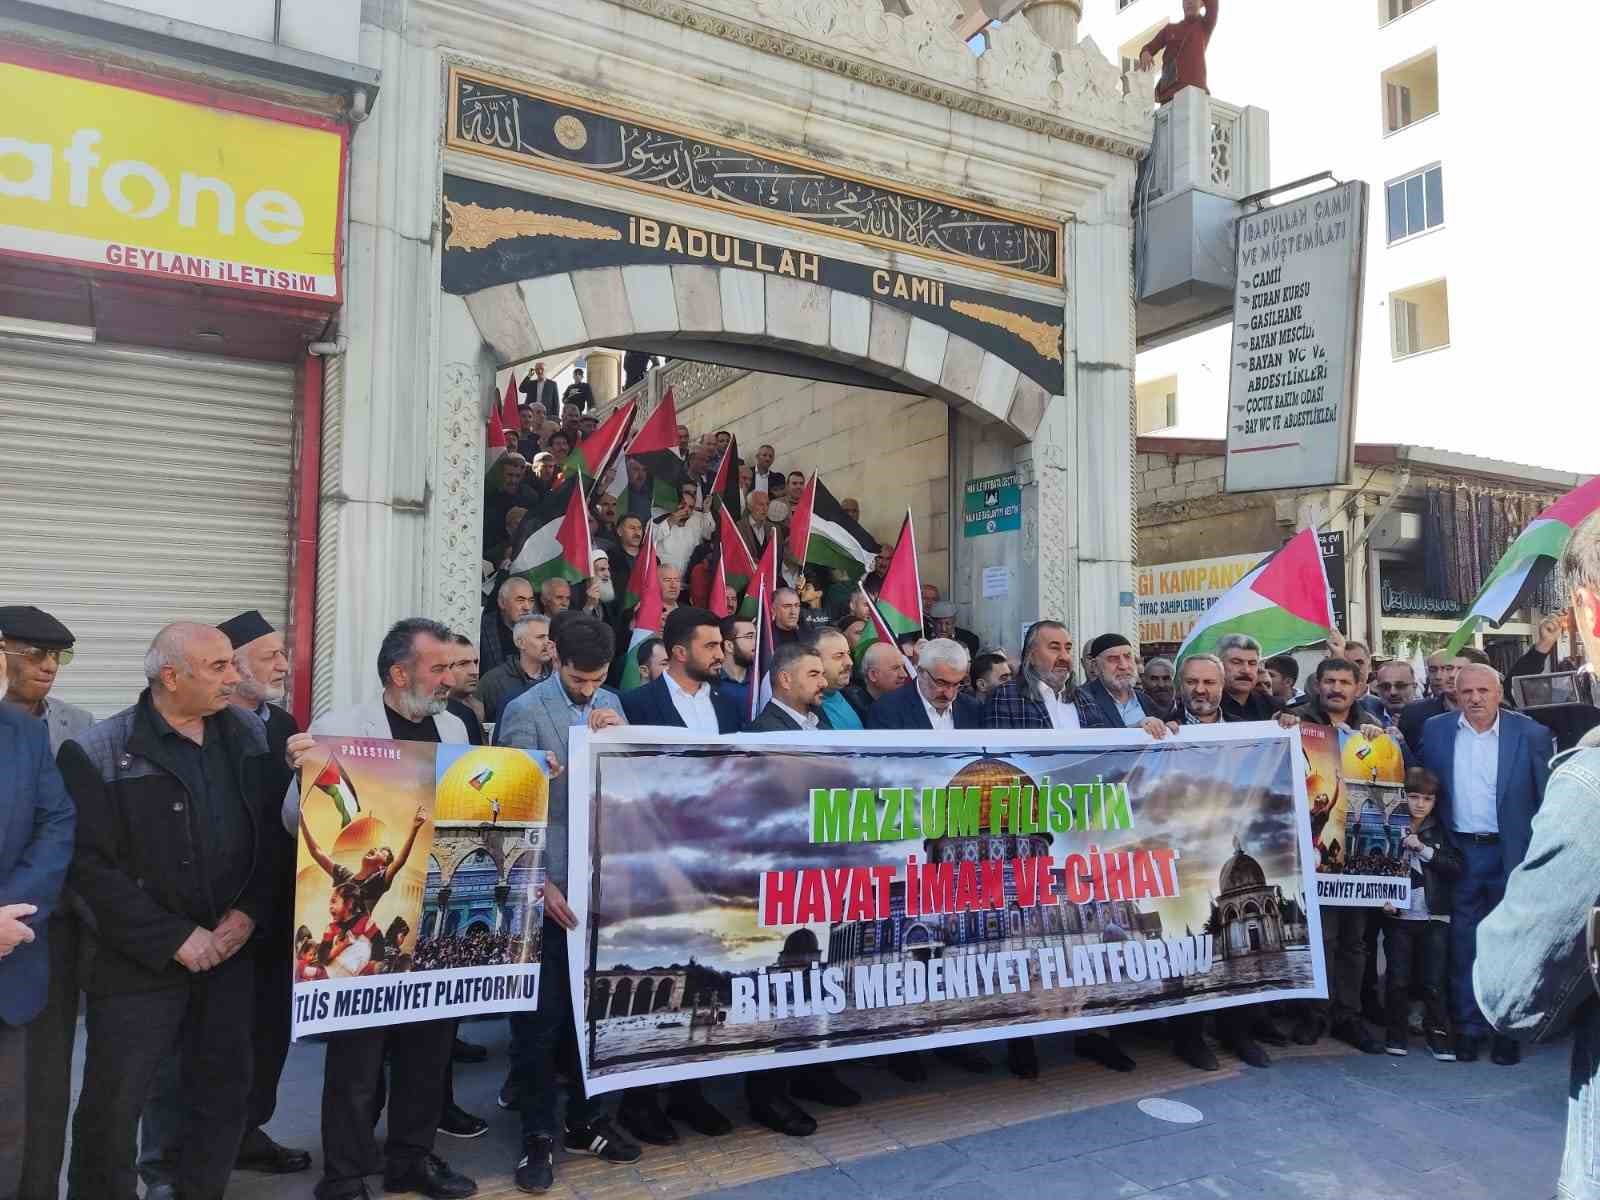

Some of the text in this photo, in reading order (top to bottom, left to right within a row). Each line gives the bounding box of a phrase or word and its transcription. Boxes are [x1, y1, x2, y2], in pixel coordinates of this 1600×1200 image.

[0, 127, 304, 246] afone
[1242, 247, 1258, 267] VE
[1251, 281, 1310, 310] KURAN KURSU
[1250, 304, 1303, 330] GASİLHANE
[1249, 331, 1278, 351] BAYAN
[1248, 352, 1283, 372] BAYAN
[1288, 347, 1306, 363] WC
[1275, 390, 1300, 409] BAKIM
[1245, 418, 1258, 435] BAY
[1259, 416, 1272, 433] WC
[1272, 414, 1282, 430] VE
[340, 743, 401, 760] PALESTINE
[808, 774, 1136, 843] MAZLUM FİLİSTİN
[758, 845, 1181, 928] HAYAT İMAN VE CİHAT
[1355, 882, 1406, 900] PLATFORMU
[295, 974, 536, 1024] TLİS MEDENİYET PLATFORMU
[727, 960, 846, 1025] BİTLİS
[854, 948, 1031, 1010] MEDENİYET
